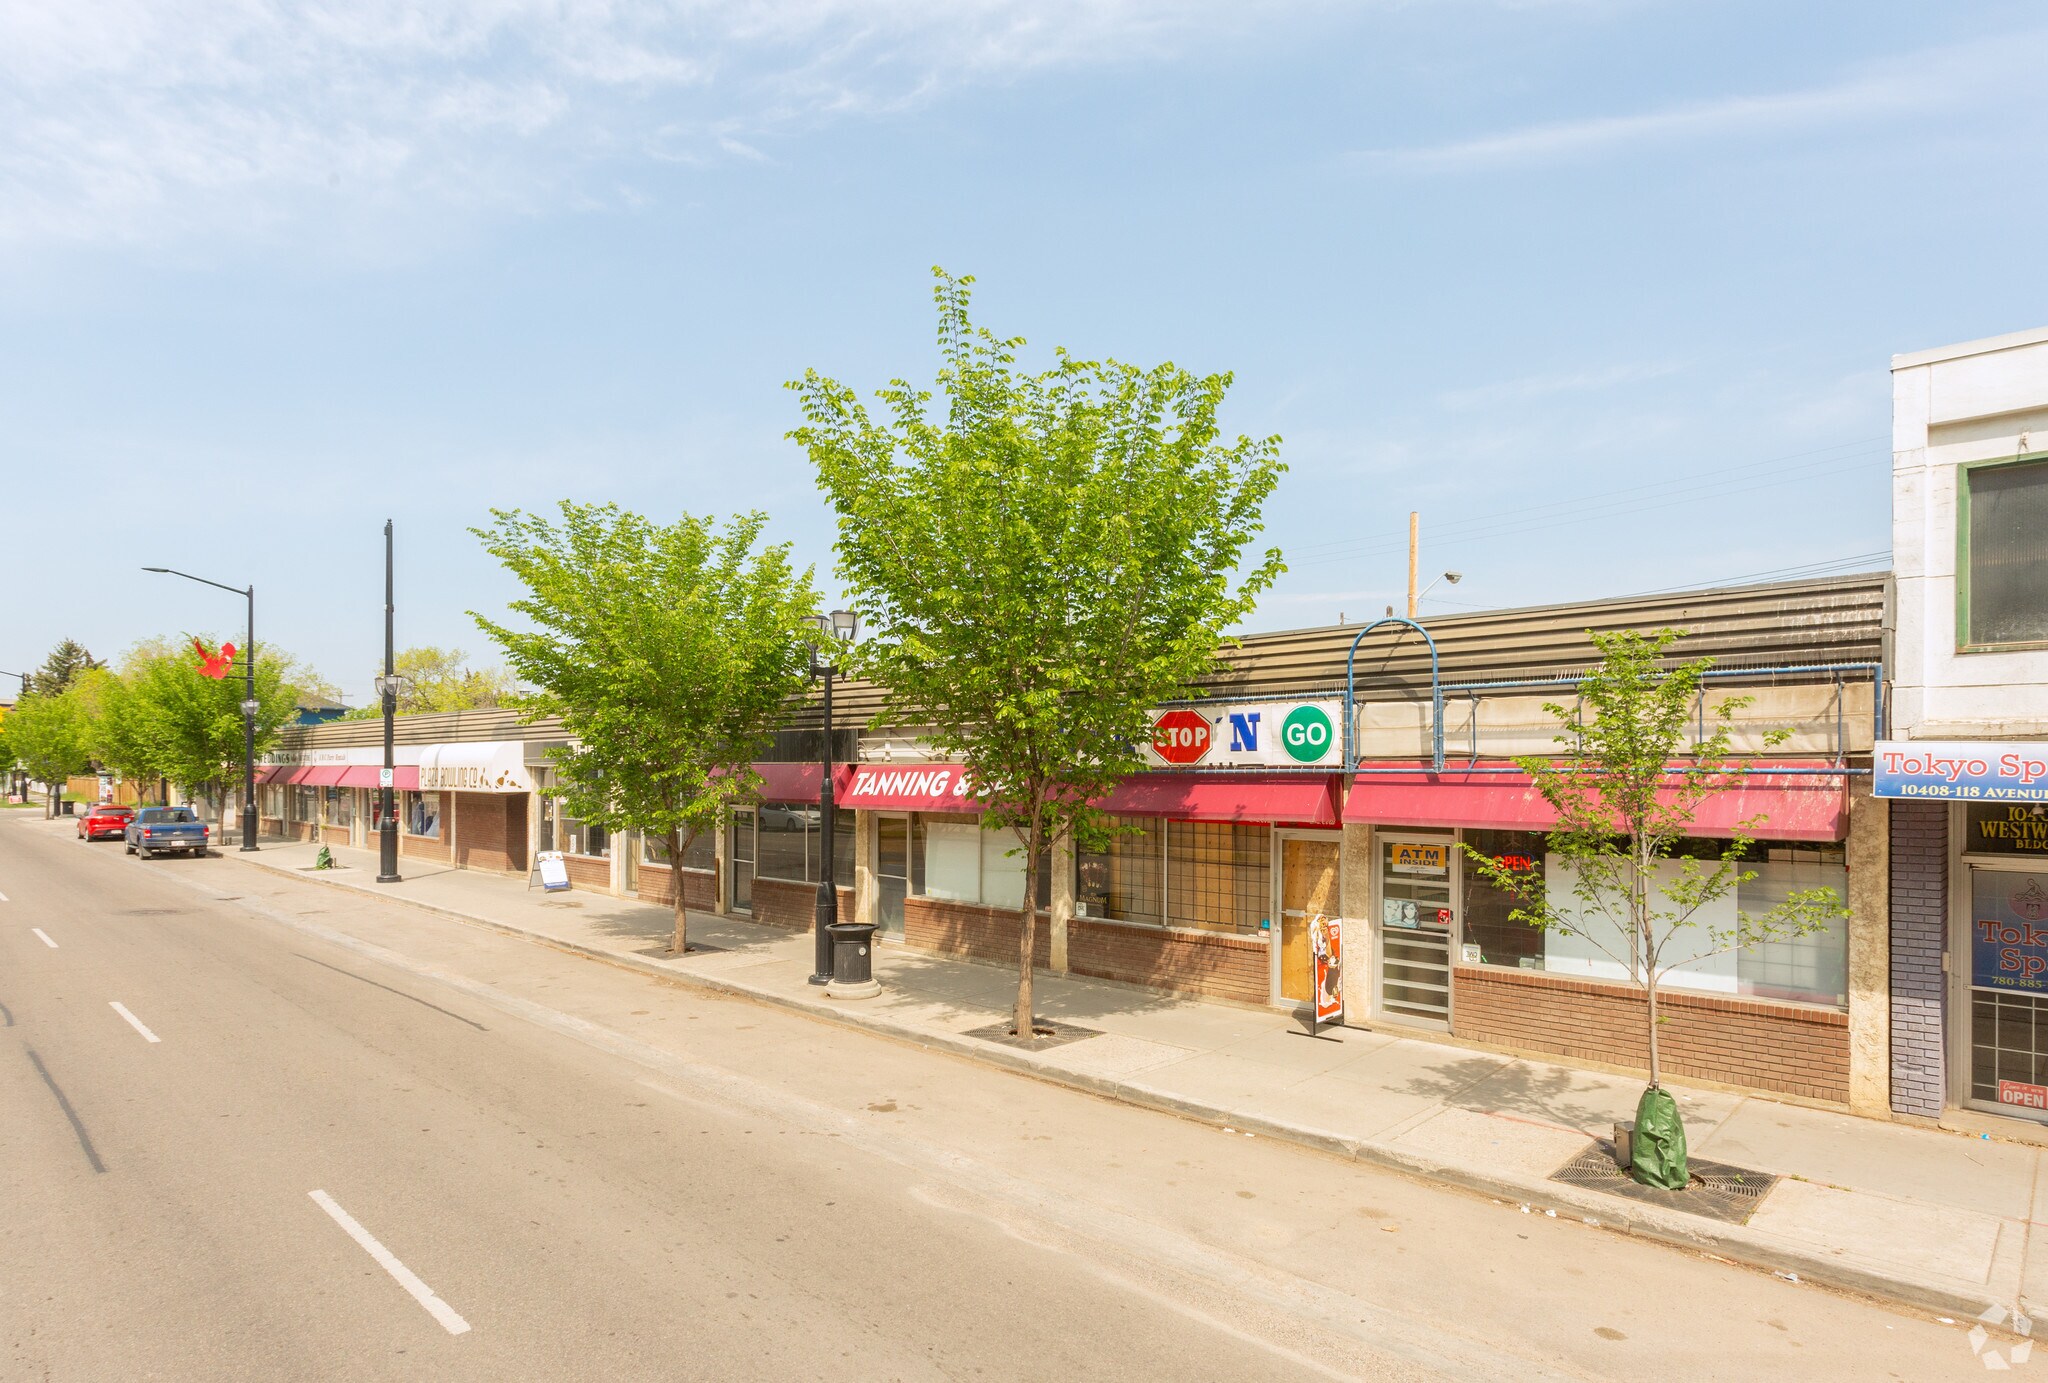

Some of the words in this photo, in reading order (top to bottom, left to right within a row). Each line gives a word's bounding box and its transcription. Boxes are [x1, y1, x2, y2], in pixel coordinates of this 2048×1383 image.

[1156, 727, 1207, 748] STOP
[1287, 722, 1327, 746] GO
[421, 767, 438, 787] PLAZA
[441, 767, 468, 788] BOWLING
[1883, 752, 1988, 782] Tokyo
[852, 771, 950, 797] TANNING
[1901, 784, 1980, 798] 10408-118
[1400, 849, 1439, 860] ATM
[1400, 859, 1438, 867] INSIDE
[1493, 855, 1531, 871] OPEN
[1978, 920, 2048, 947] Tok
[2000, 948, 2048, 978] Sp
[2003, 1089, 2044, 1108] OPEN
